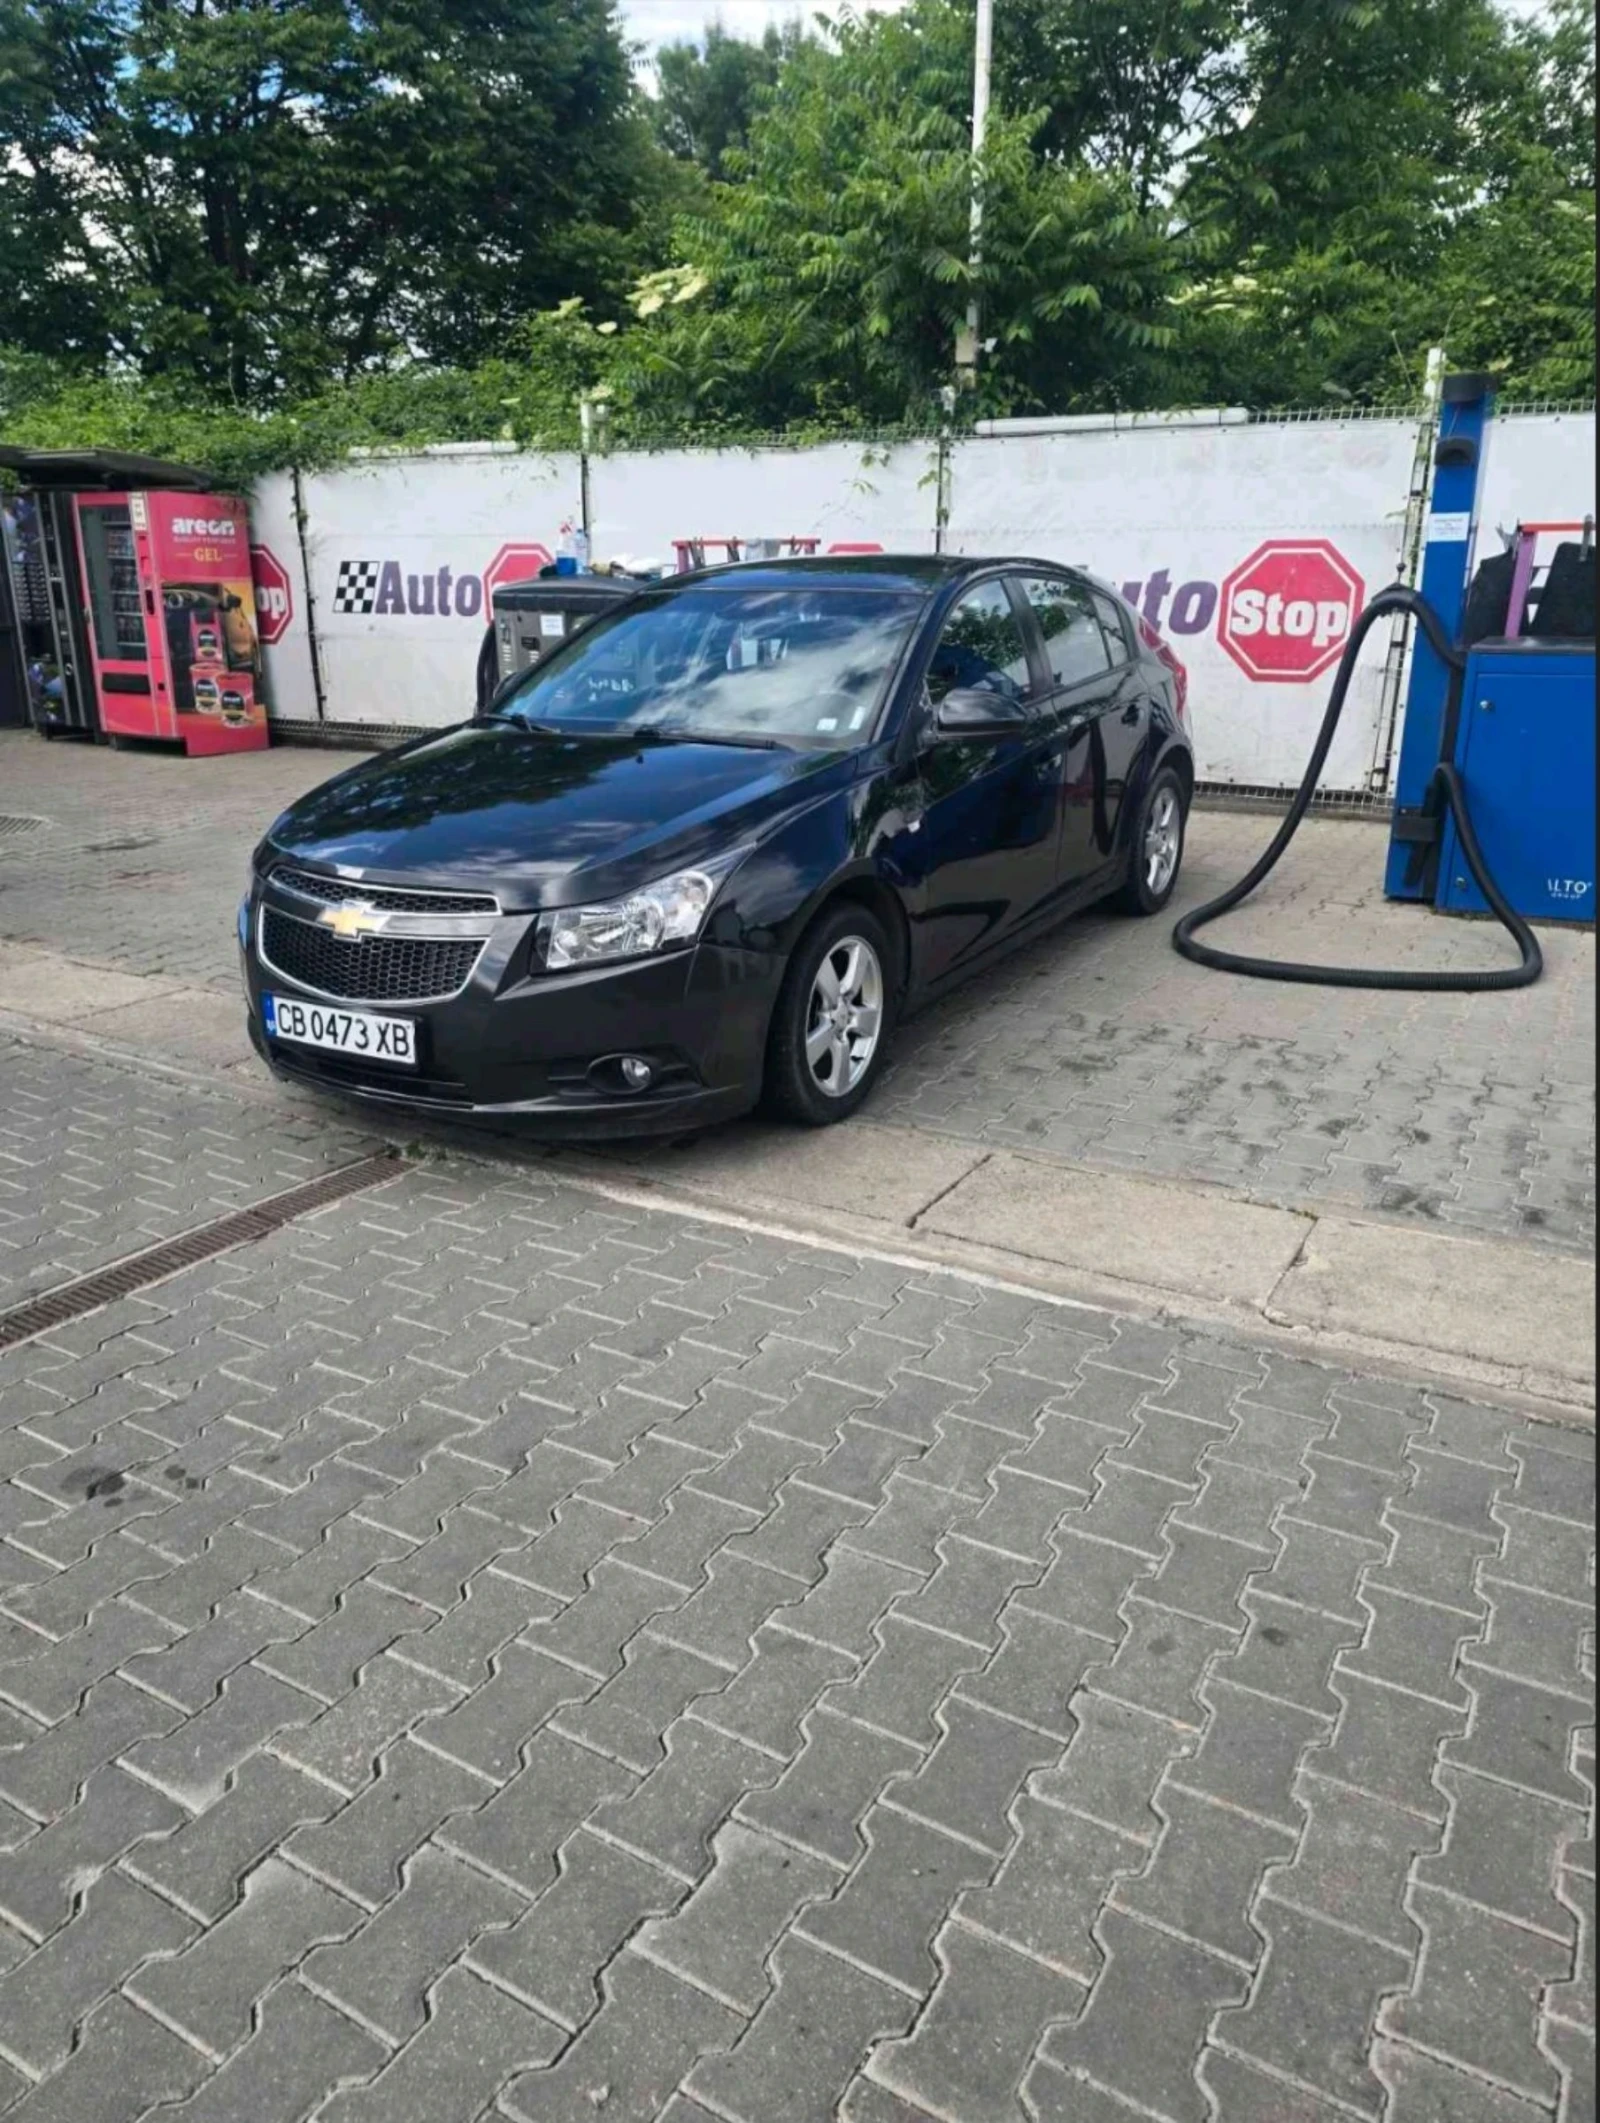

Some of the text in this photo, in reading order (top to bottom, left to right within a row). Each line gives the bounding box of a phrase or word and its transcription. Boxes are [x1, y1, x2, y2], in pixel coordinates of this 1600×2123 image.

[194, 547, 222, 562] GEL
[256, 586, 286, 620] op
[375, 560, 482, 617] Auto
[1112, 568, 1348, 647] to Stop
[277, 1003, 410, 1056] CB 0473 XB
